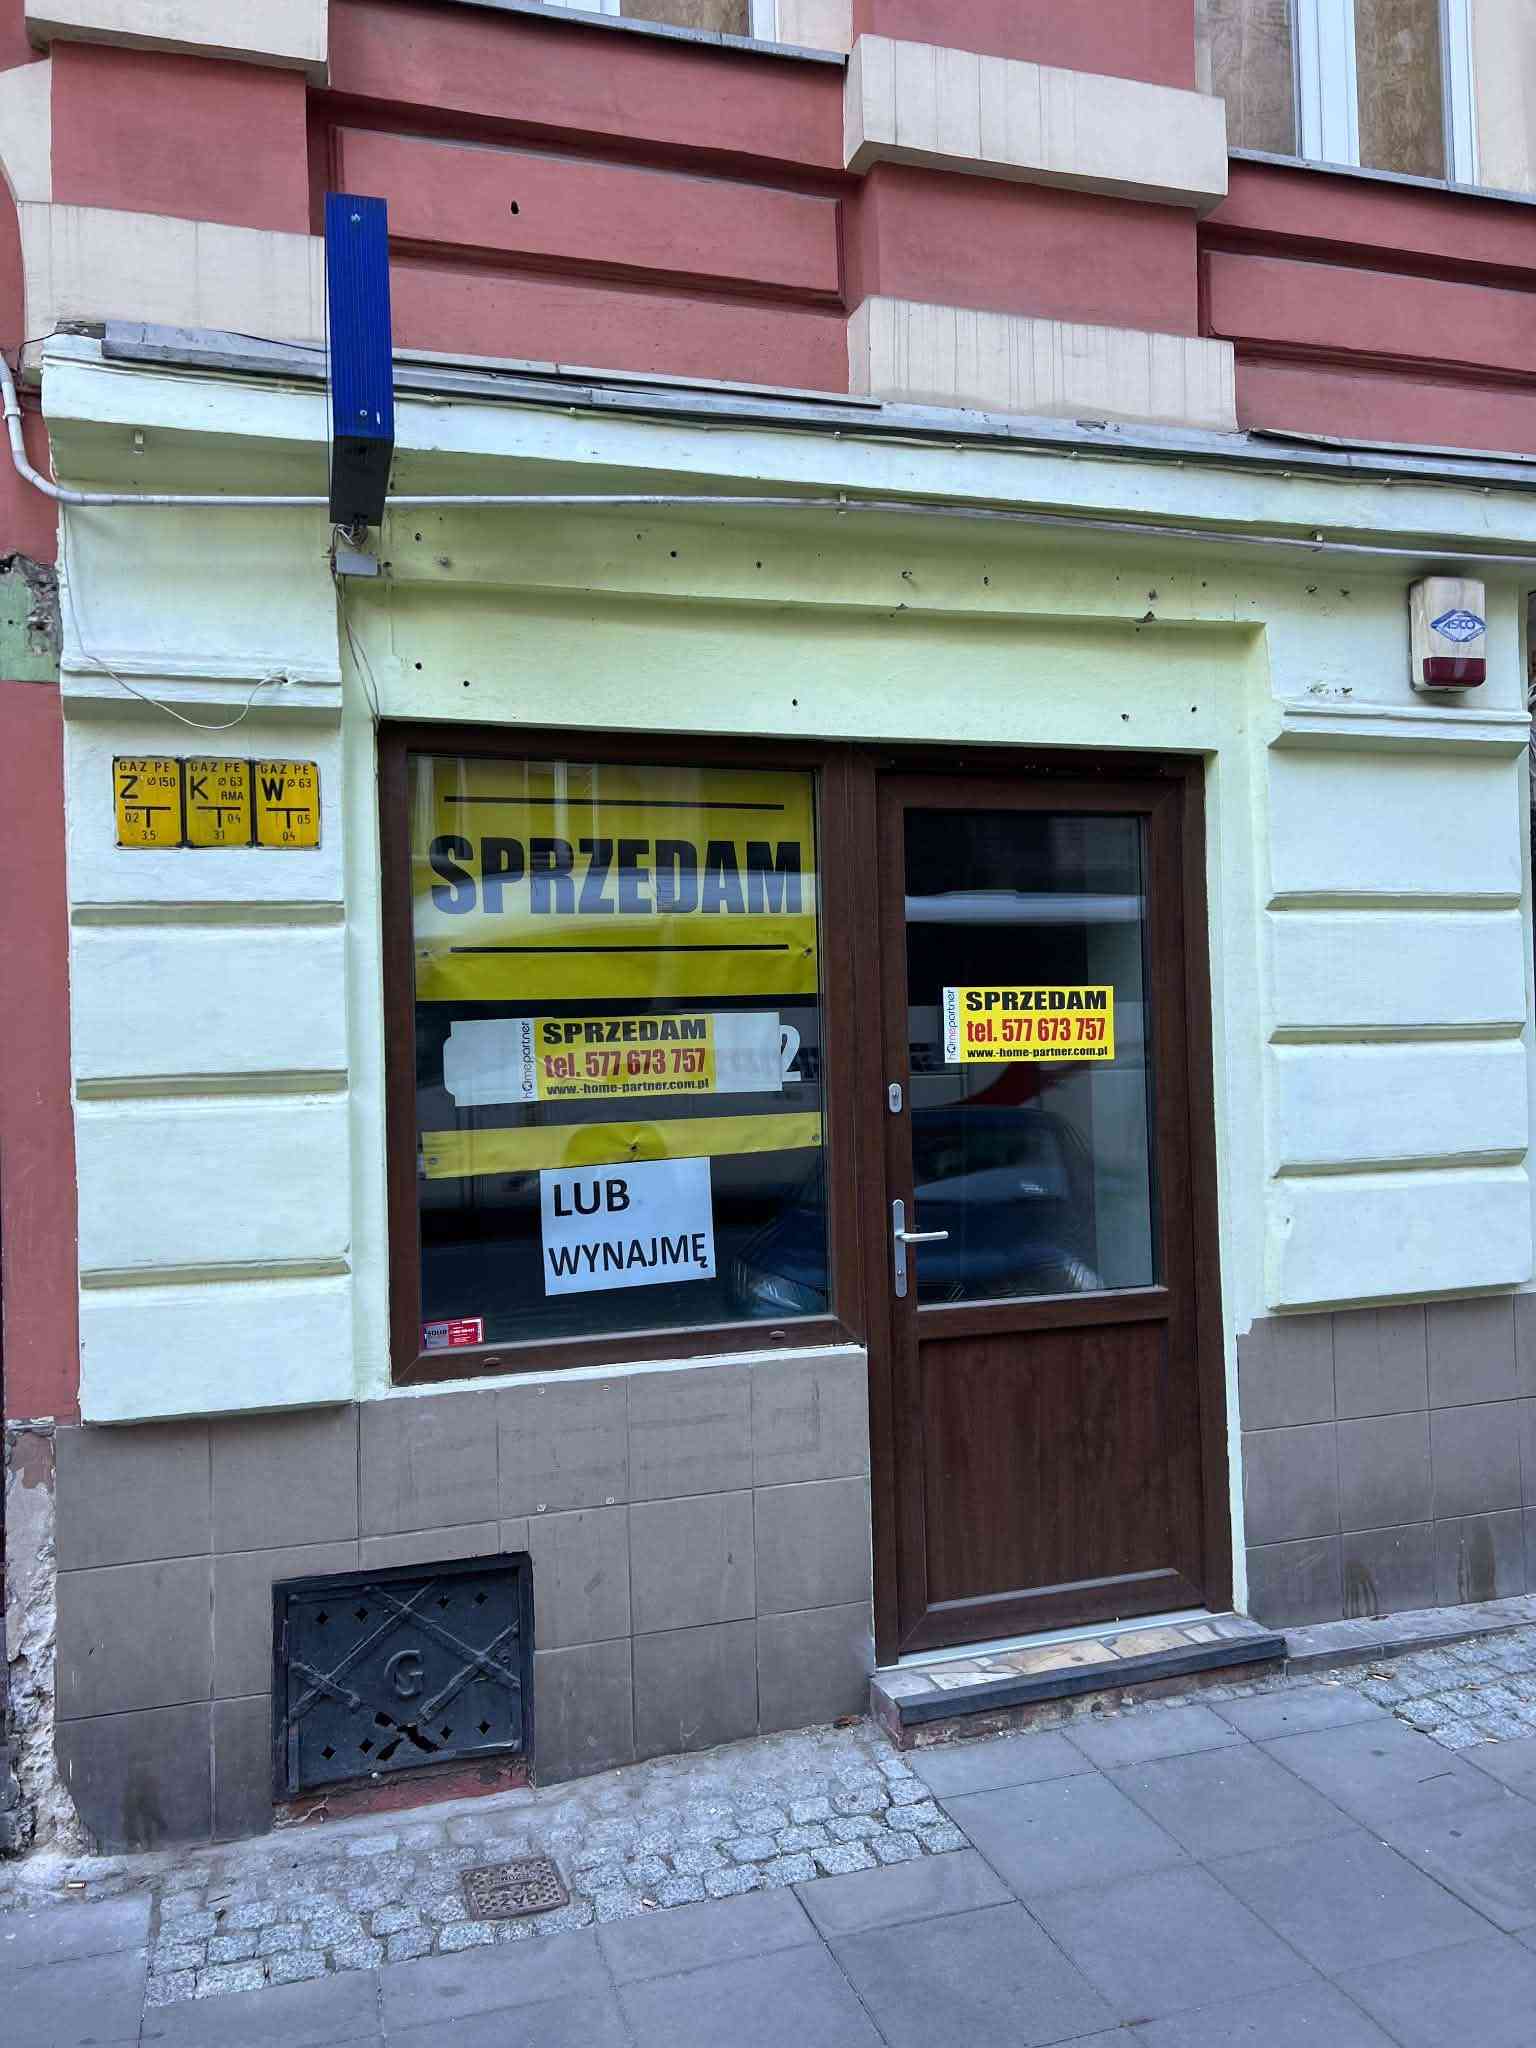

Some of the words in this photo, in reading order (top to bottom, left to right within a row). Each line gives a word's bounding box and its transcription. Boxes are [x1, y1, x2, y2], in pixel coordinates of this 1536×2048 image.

[120, 761, 147, 772] GAZ
[154, 762, 170, 773] PE
[191, 762, 217, 773] GAZ
[224, 763, 241, 773] PE
[260, 764, 287, 775] GAZ
[294, 765, 309, 775] PE
[120, 775, 138, 799] Z
[190, 776, 208, 800] K
[261, 778, 285, 802] W
[428, 834, 802, 915] SPRZEDAM
[965, 990, 1107, 1011] SPRZEDAM
[542, 1019, 707, 1044] SPRZEDAM
[966, 1019, 998, 1042] tel.
[1002, 1018, 1033, 1042] 577
[1037, 1017, 1071, 1041] 673
[1075, 1017, 1106, 1041] 757
[544, 1053, 581, 1078] tel.
[585, 1051, 621, 1078] 577
[626, 1049, 667, 1076] 673
[671, 1047, 706, 1074] 757
[553, 1179, 630, 1217] LUB
[548, 1232, 708, 1277] WYNAJMĘ
[383, 1650, 424, 1697] G
